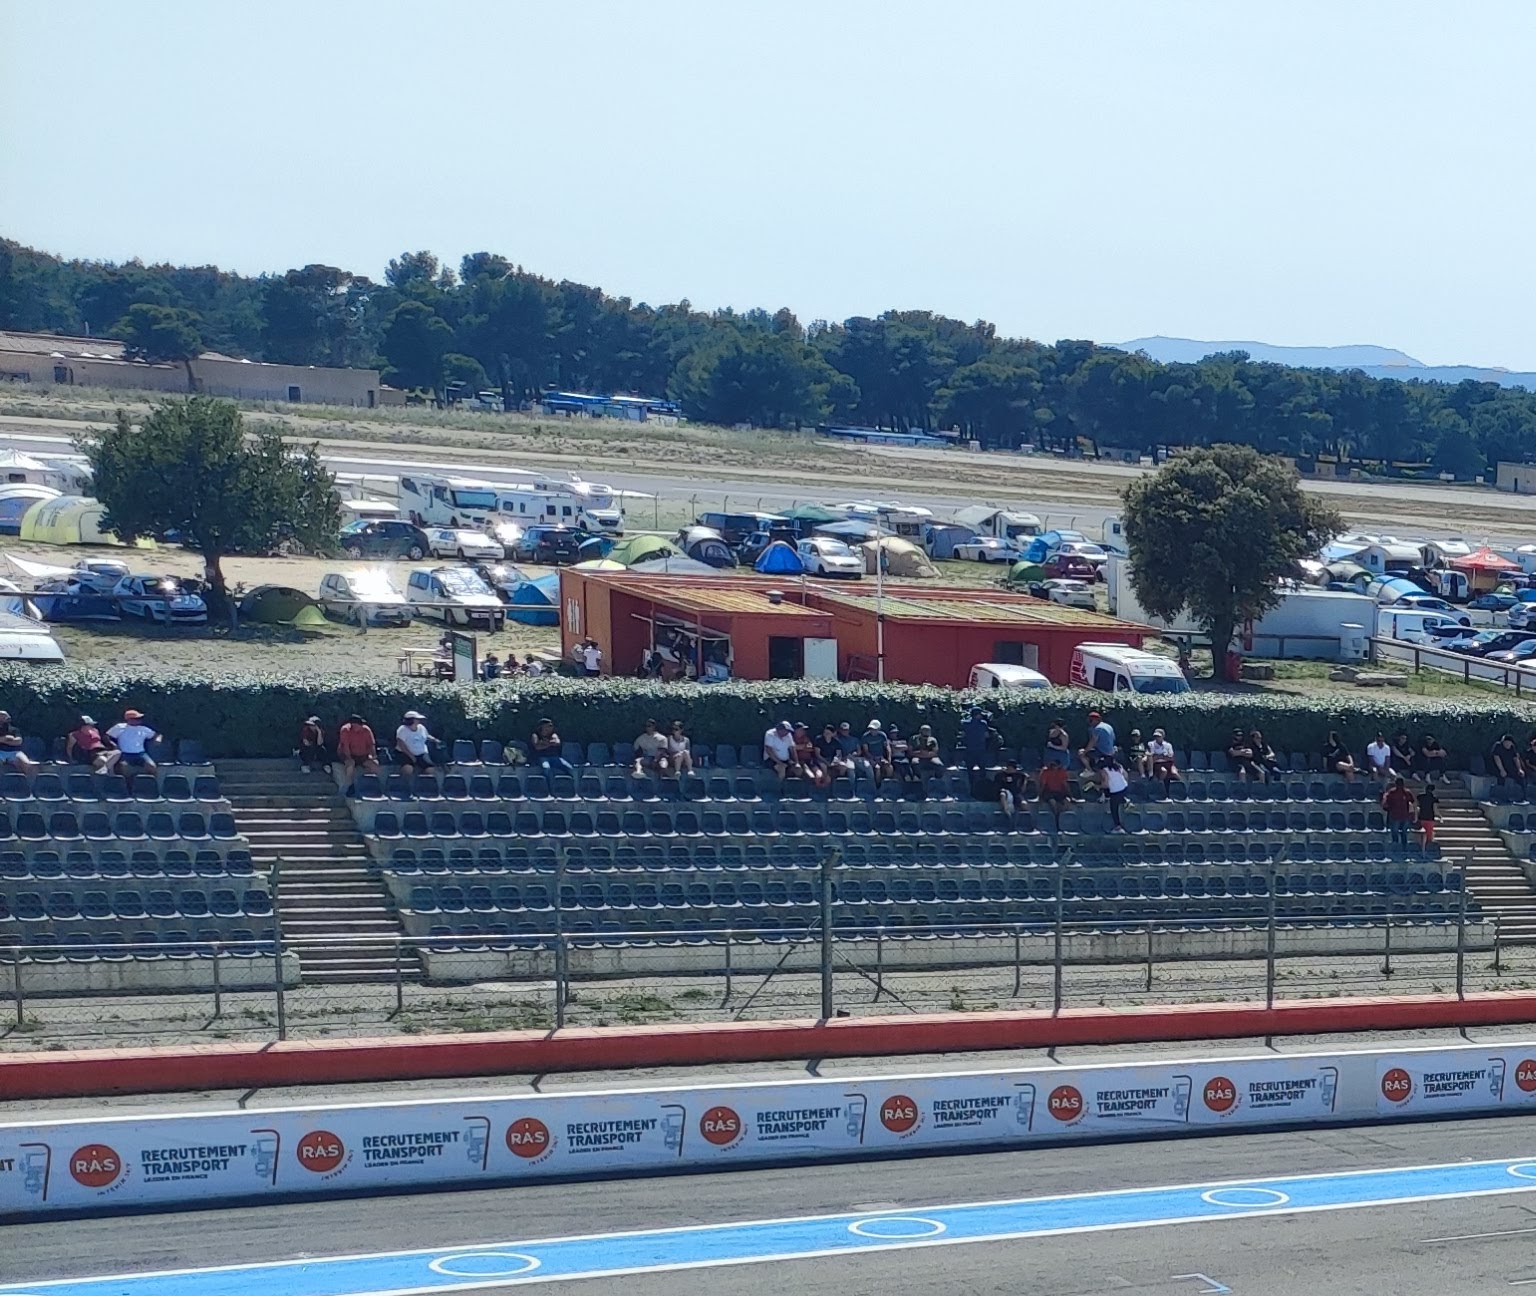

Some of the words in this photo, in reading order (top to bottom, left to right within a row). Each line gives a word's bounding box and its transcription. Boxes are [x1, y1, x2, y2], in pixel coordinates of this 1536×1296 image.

[1424, 1070, 1486, 1083] RECRUTEMENT
[1249, 1078, 1317, 1092] RECRUTEMENT
[1424, 1080, 1476, 1093] TRANSPORT
[1097, 1088, 1169, 1100] RECRUTEMENT
[1250, 1090, 1305, 1102] TRANSPORT
[933, 1096, 1011, 1111] RECRUTEMENT
[1097, 1099, 1157, 1112] TRANSPORT
[756, 1107, 841, 1122] RECRUTEMENT
[933, 1108, 998, 1122] TRANSPORT
[567, 1118, 658, 1134] RECRUTEMENT
[757, 1120, 826, 1134] TRANSPORT
[362, 1131, 460, 1148] RECRUTEMENT
[567, 1132, 643, 1147] TRANSPORT
[141, 1145, 247, 1162] RECRUTEMENT
[363, 1145, 444, 1161] TRANSPORT
[142, 1159, 230, 1175] TRANSPORT
